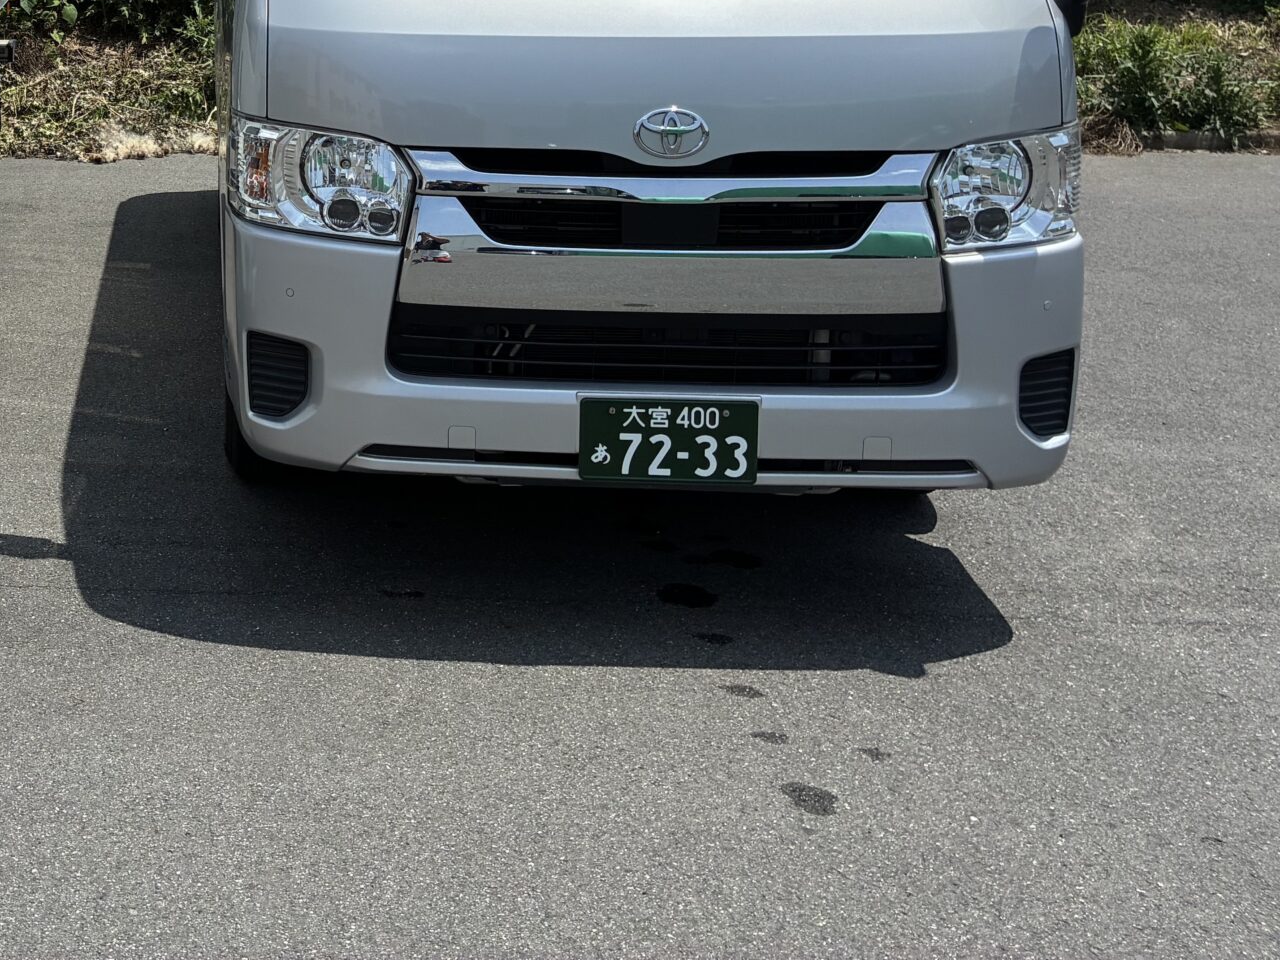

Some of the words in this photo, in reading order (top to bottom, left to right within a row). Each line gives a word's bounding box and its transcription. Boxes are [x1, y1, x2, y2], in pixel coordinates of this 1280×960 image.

[676, 406, 719, 429] 400
[590, 443, 611, 464] あ
[619, 433, 748, 478] 72-33
